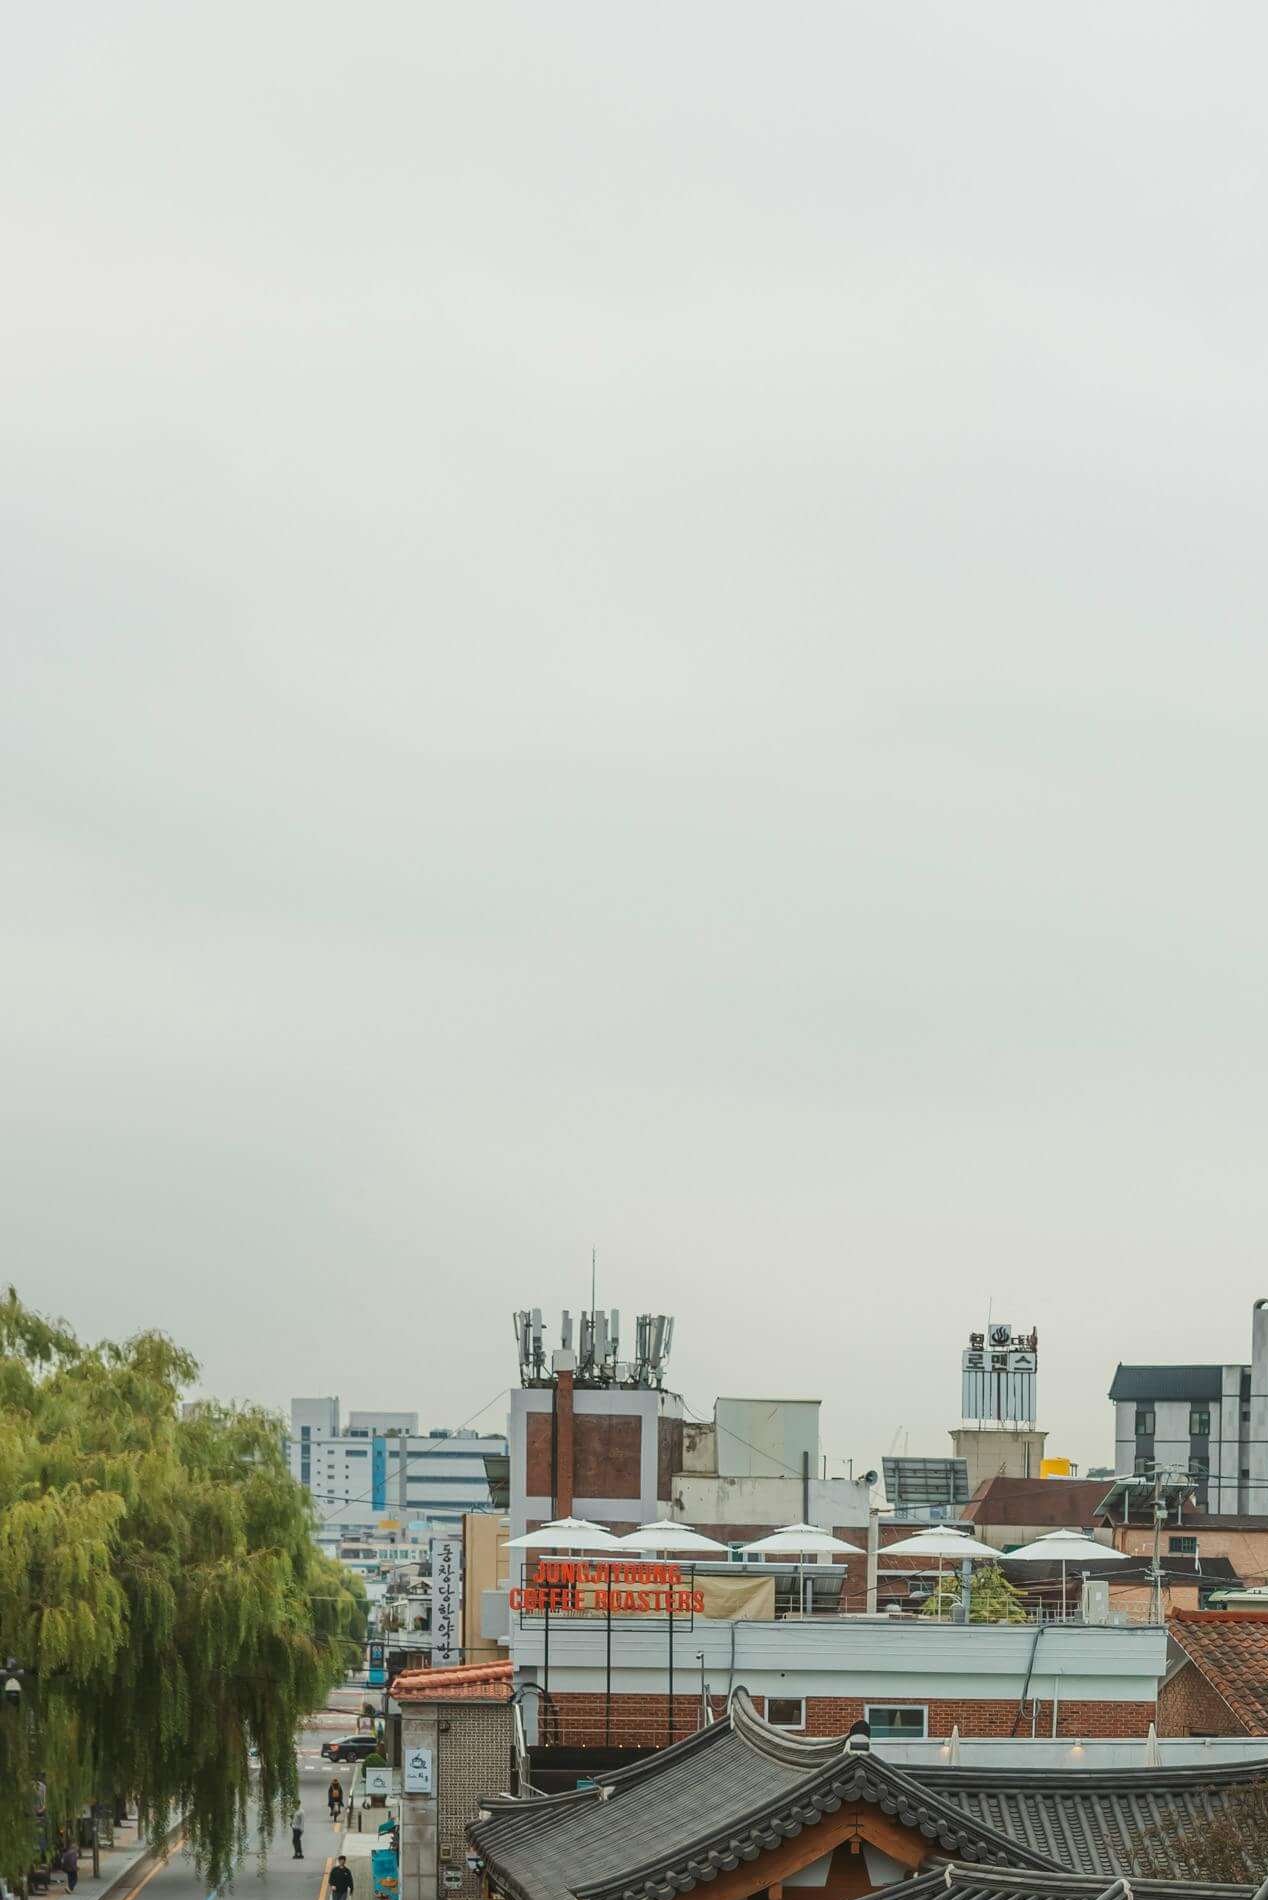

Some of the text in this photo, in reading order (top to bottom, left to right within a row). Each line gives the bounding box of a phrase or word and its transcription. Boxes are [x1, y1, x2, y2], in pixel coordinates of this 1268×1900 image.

[966, 1353, 1033, 1371] 로맨스
[508, 1587, 705, 1614] COFFEE ROASTERS
